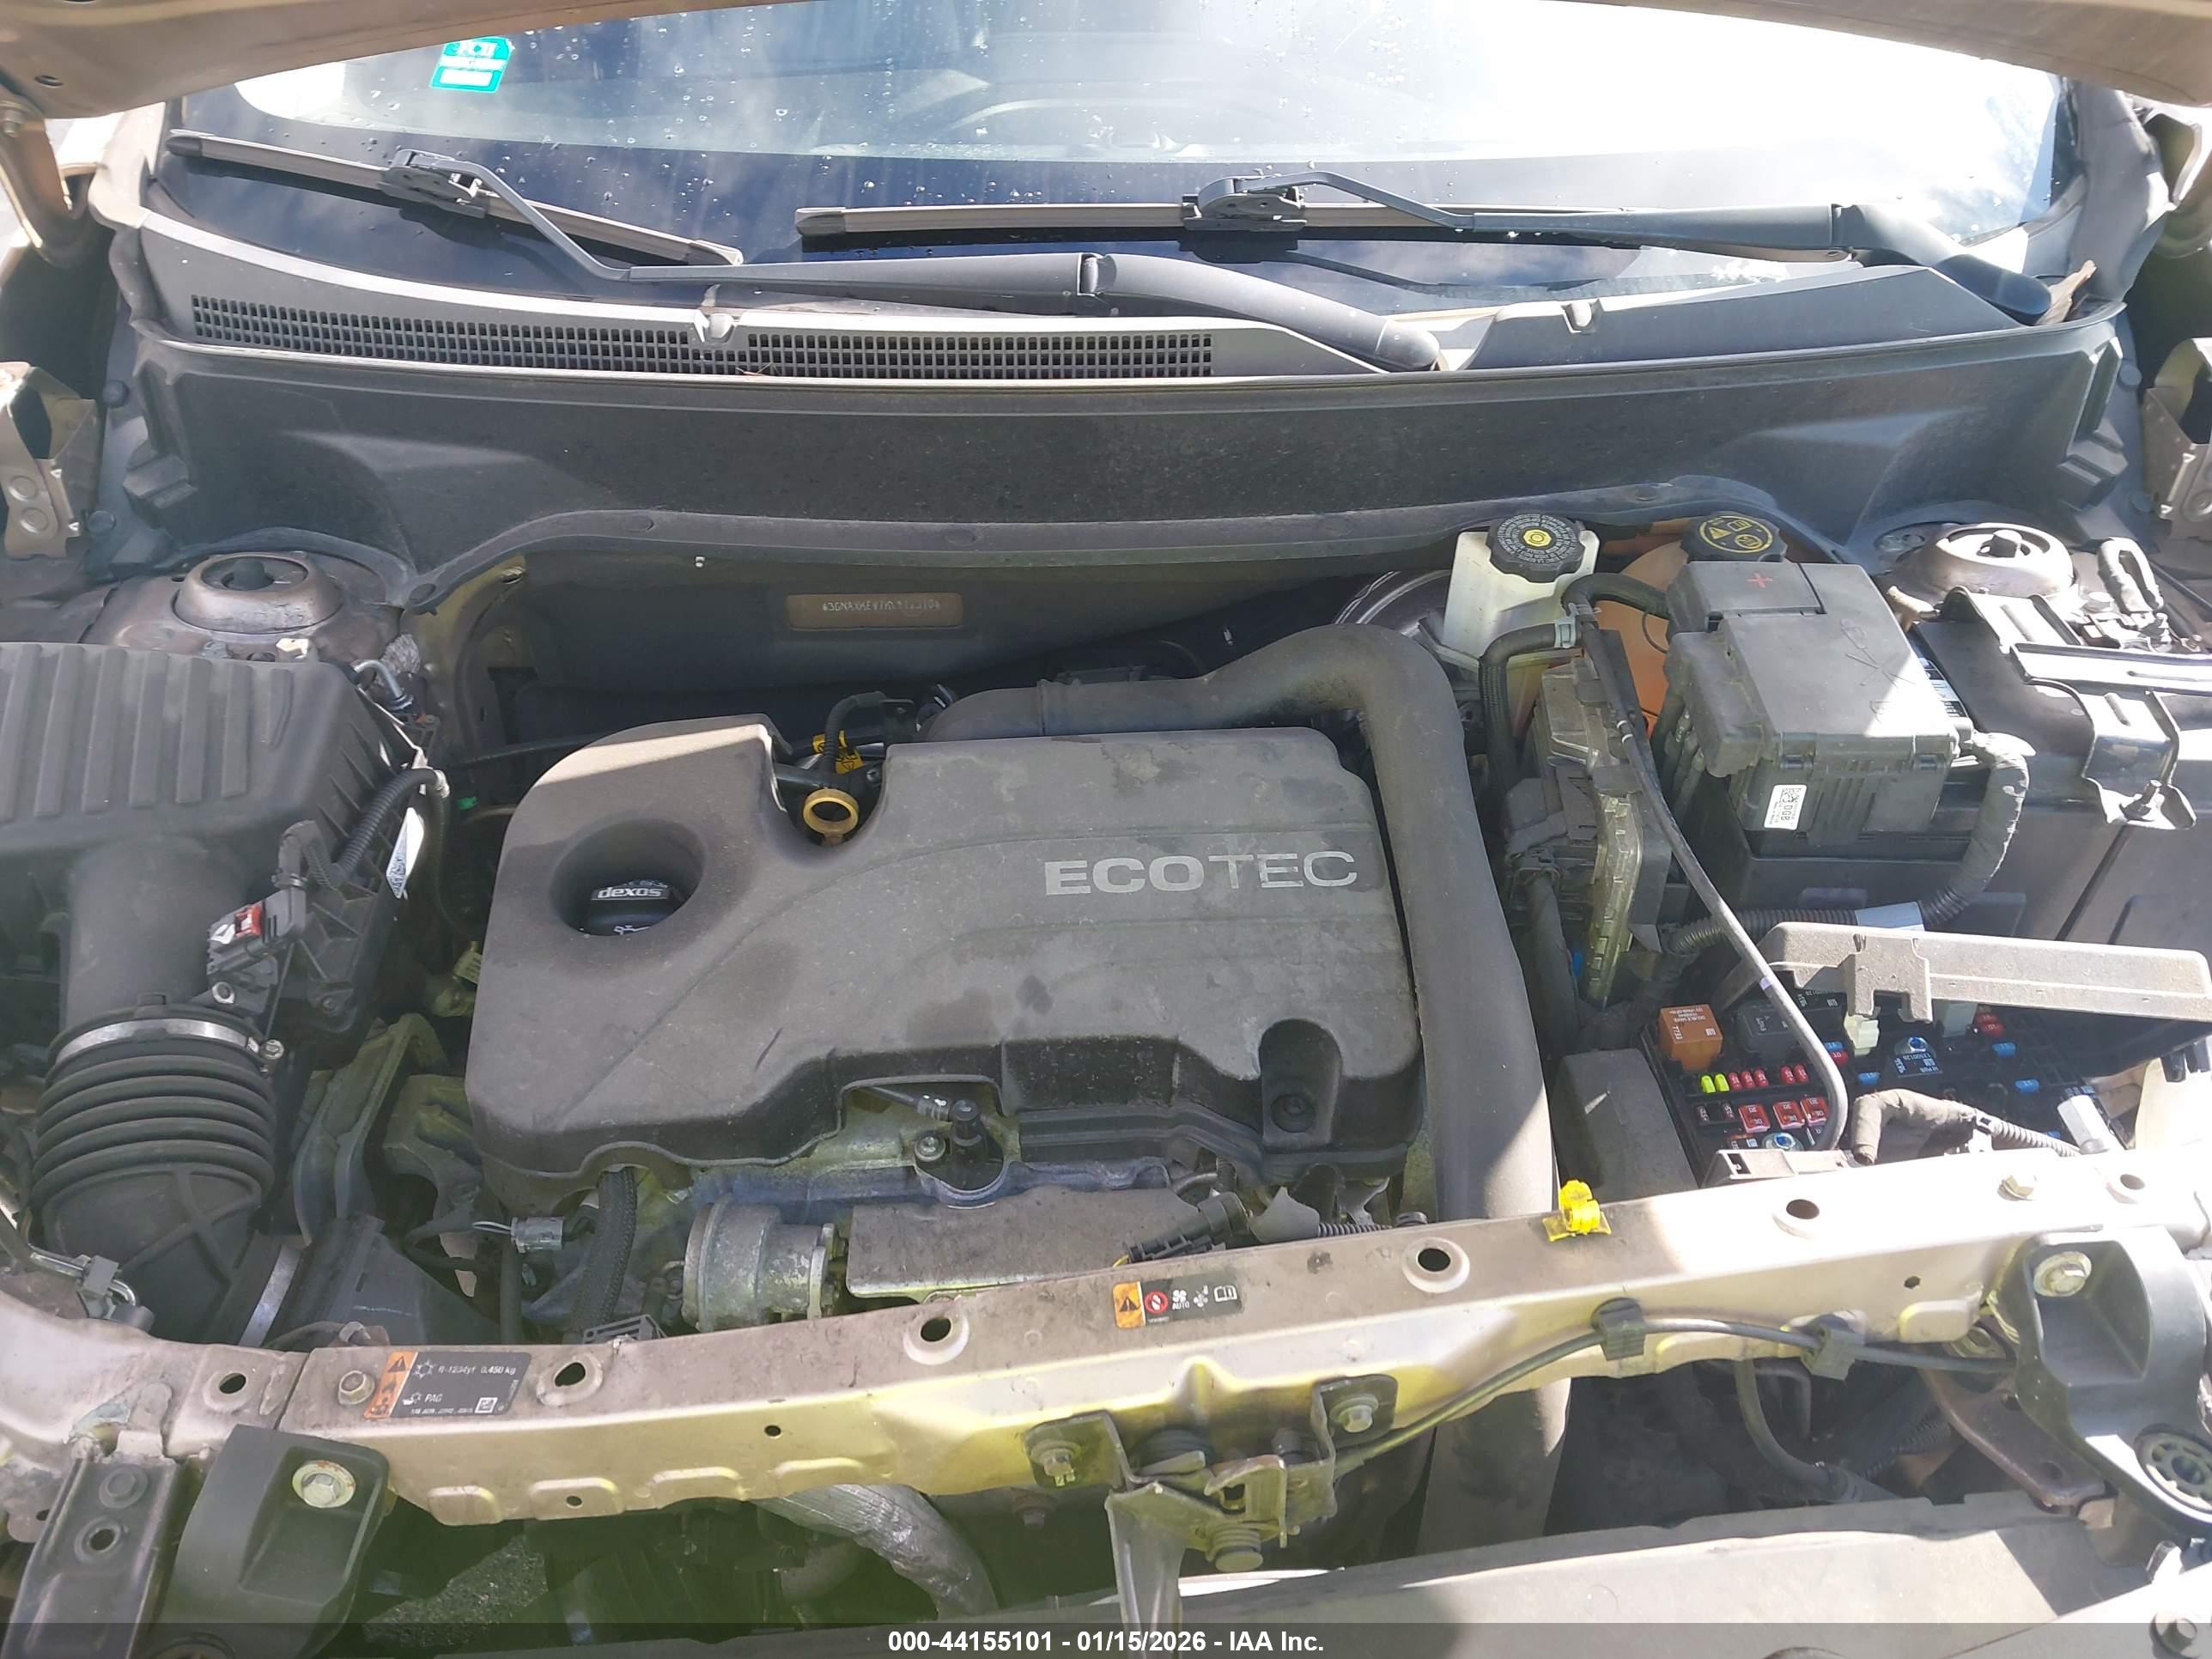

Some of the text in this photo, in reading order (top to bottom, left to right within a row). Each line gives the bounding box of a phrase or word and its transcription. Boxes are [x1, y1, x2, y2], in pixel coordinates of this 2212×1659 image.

[1044, 850, 1358, 896] ECOTEC
[597, 886, 663, 898] dexos
[1171, 1301, 1190, 1310] AUTO
[480, 1365, 503, 1375] 0.450
[505, 1365, 517, 1376] kg
[424, 1394, 443, 1402] PAG
